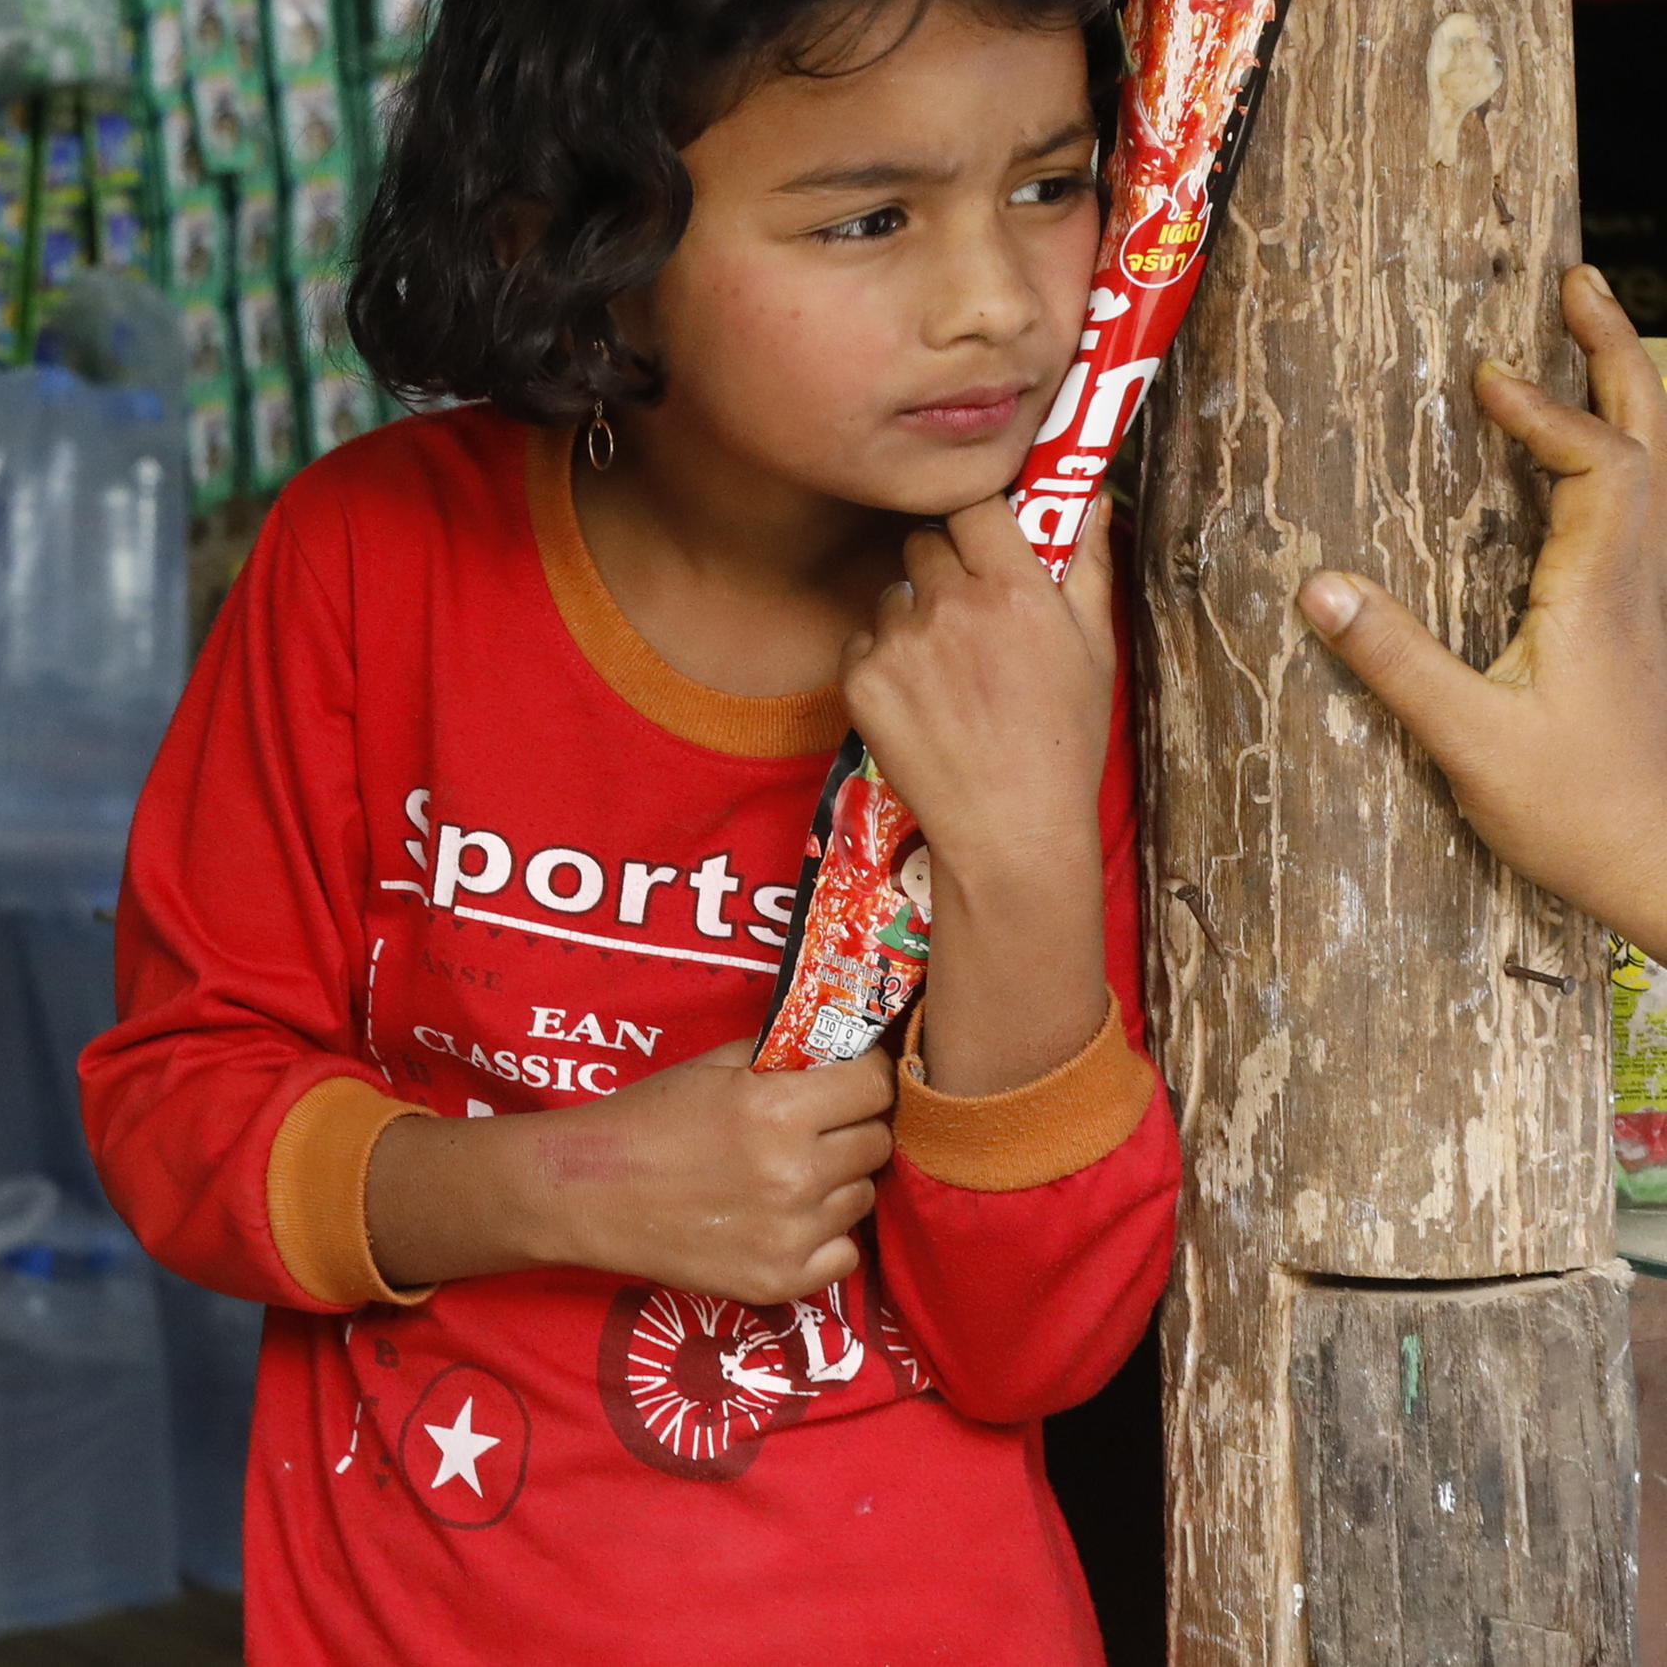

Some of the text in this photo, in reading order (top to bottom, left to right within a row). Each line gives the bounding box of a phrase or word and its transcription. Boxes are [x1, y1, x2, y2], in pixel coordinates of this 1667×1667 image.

[1158, 210, 1202, 245] เผ็ด
[404, 787, 797, 948] Sports
[820, 966, 838, 984] Net
[527, 1006, 664, 1058] EAN
[818, 1017, 837, 1033] 110
[845, 1028, 854, 1040] 0
[413, 1024, 618, 1096] CLASSIC
